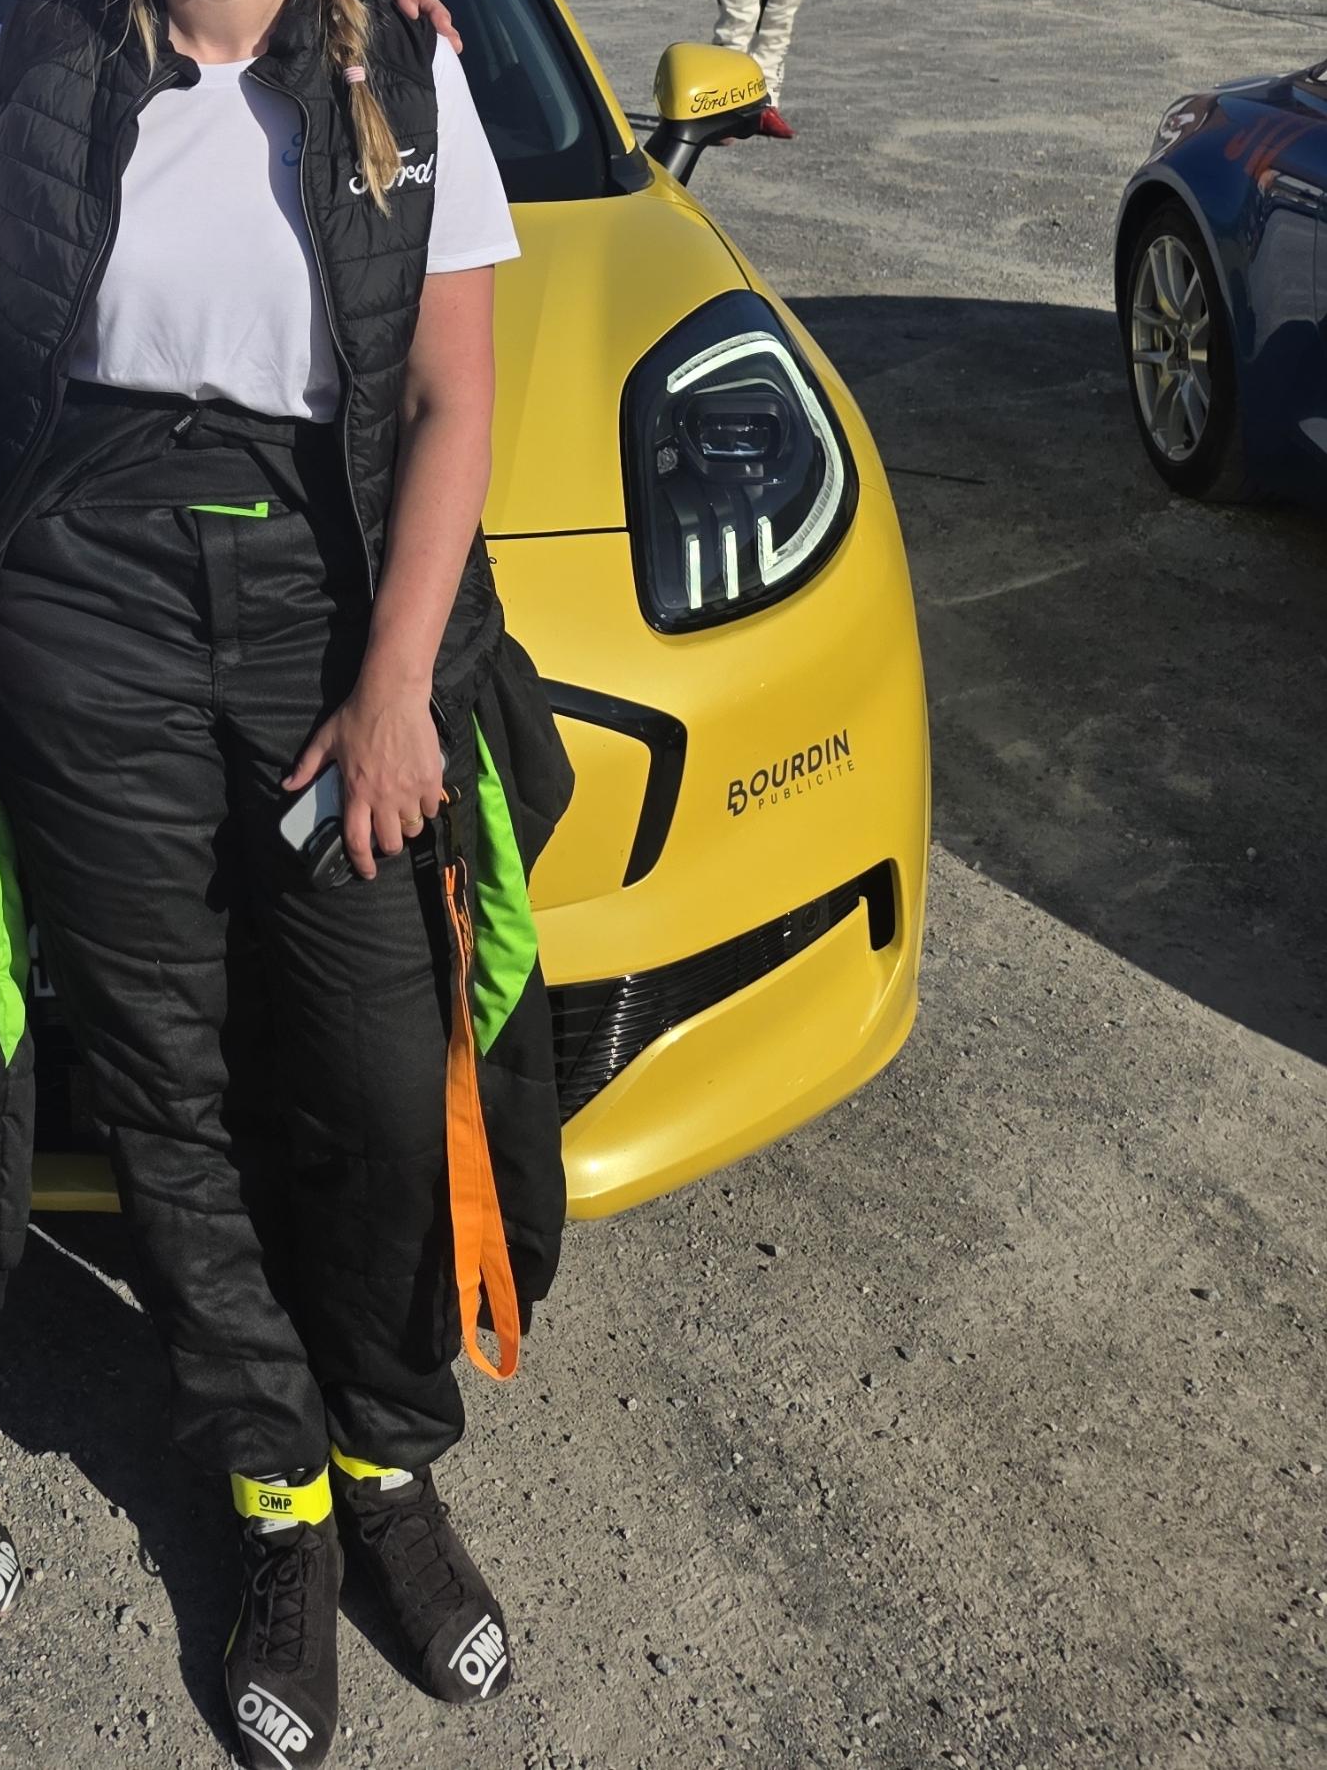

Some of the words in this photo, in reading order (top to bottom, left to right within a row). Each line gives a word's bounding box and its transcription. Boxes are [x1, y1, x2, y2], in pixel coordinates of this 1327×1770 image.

[690, 90, 727, 113] Ford
[730, 88, 745, 103] Ev
[727, 728, 850, 817] BOURDIN
[758, 760, 854, 810] PUBLICITE
[259, 1494, 292, 1511] OMP
[459, 1622, 503, 1685] OMP
[237, 1693, 308, 1753] OMP
